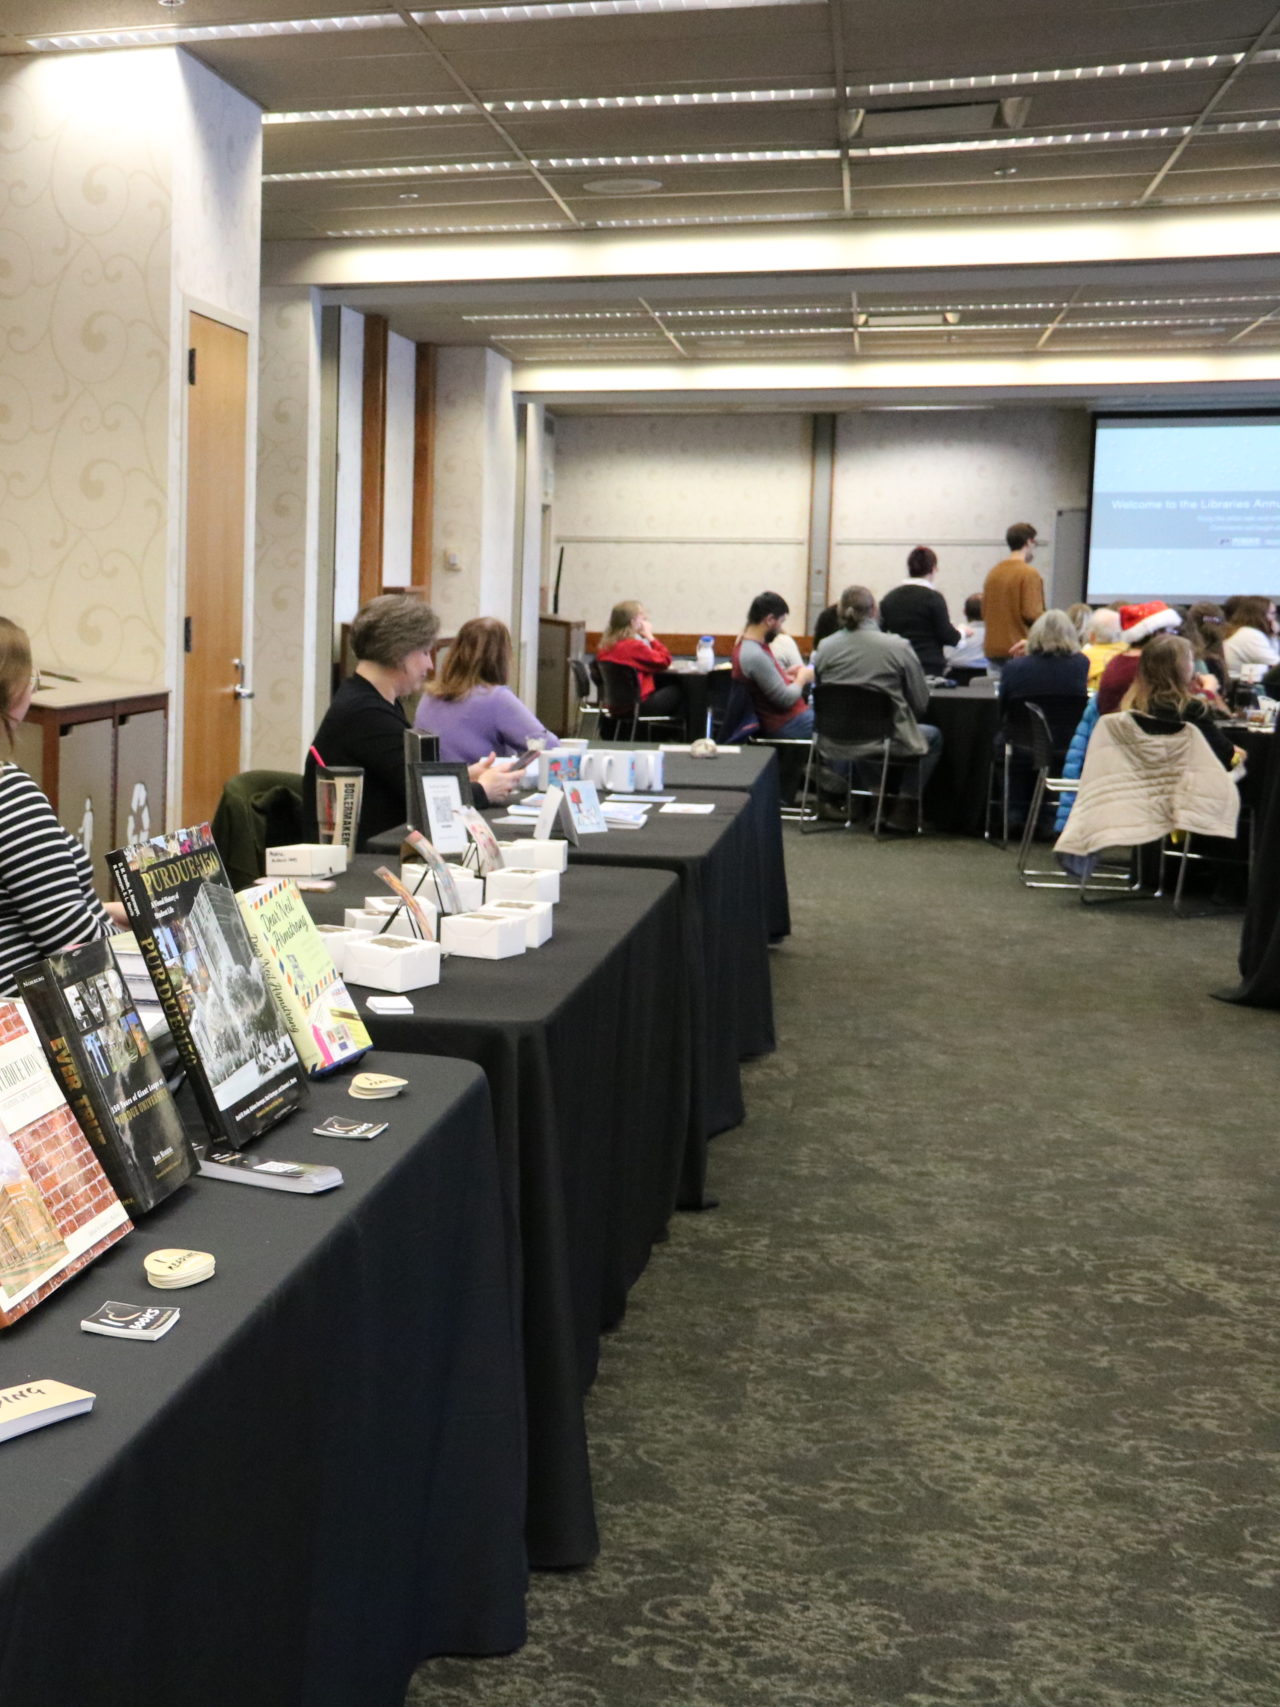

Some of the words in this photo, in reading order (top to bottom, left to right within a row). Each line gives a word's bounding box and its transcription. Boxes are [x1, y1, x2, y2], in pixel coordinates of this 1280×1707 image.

[1111, 499, 1163, 509] Welcome
[1166, 501, 1176, 509] to
[1179, 500, 1197, 509] the
[1200, 499, 1250, 509] Libraries
[140, 856, 200, 896] PURDUE
[200, 850, 220, 875] 150
[260, 910, 279, 932] Dear
[276, 897, 294, 920] Neil
[271, 916, 309, 951] Armstrong
[64, 968, 133, 1031] EVER
[141, 936, 184, 1030] PURDUE
[249, 935, 263, 957] Dear
[263, 958, 274, 980] Neil
[269, 979, 299, 1033] Armstrong
[20, 1054, 42, 1077] ICON
[50, 1036, 82, 1091] EVER
[120, 1097, 133, 1108] Years
[133, 1092, 138, 1101] of
[137, 1087, 149, 1099] Giant
[99, 1318, 126, 1326] I
[129, 1308, 160, 1330] BOOKS
